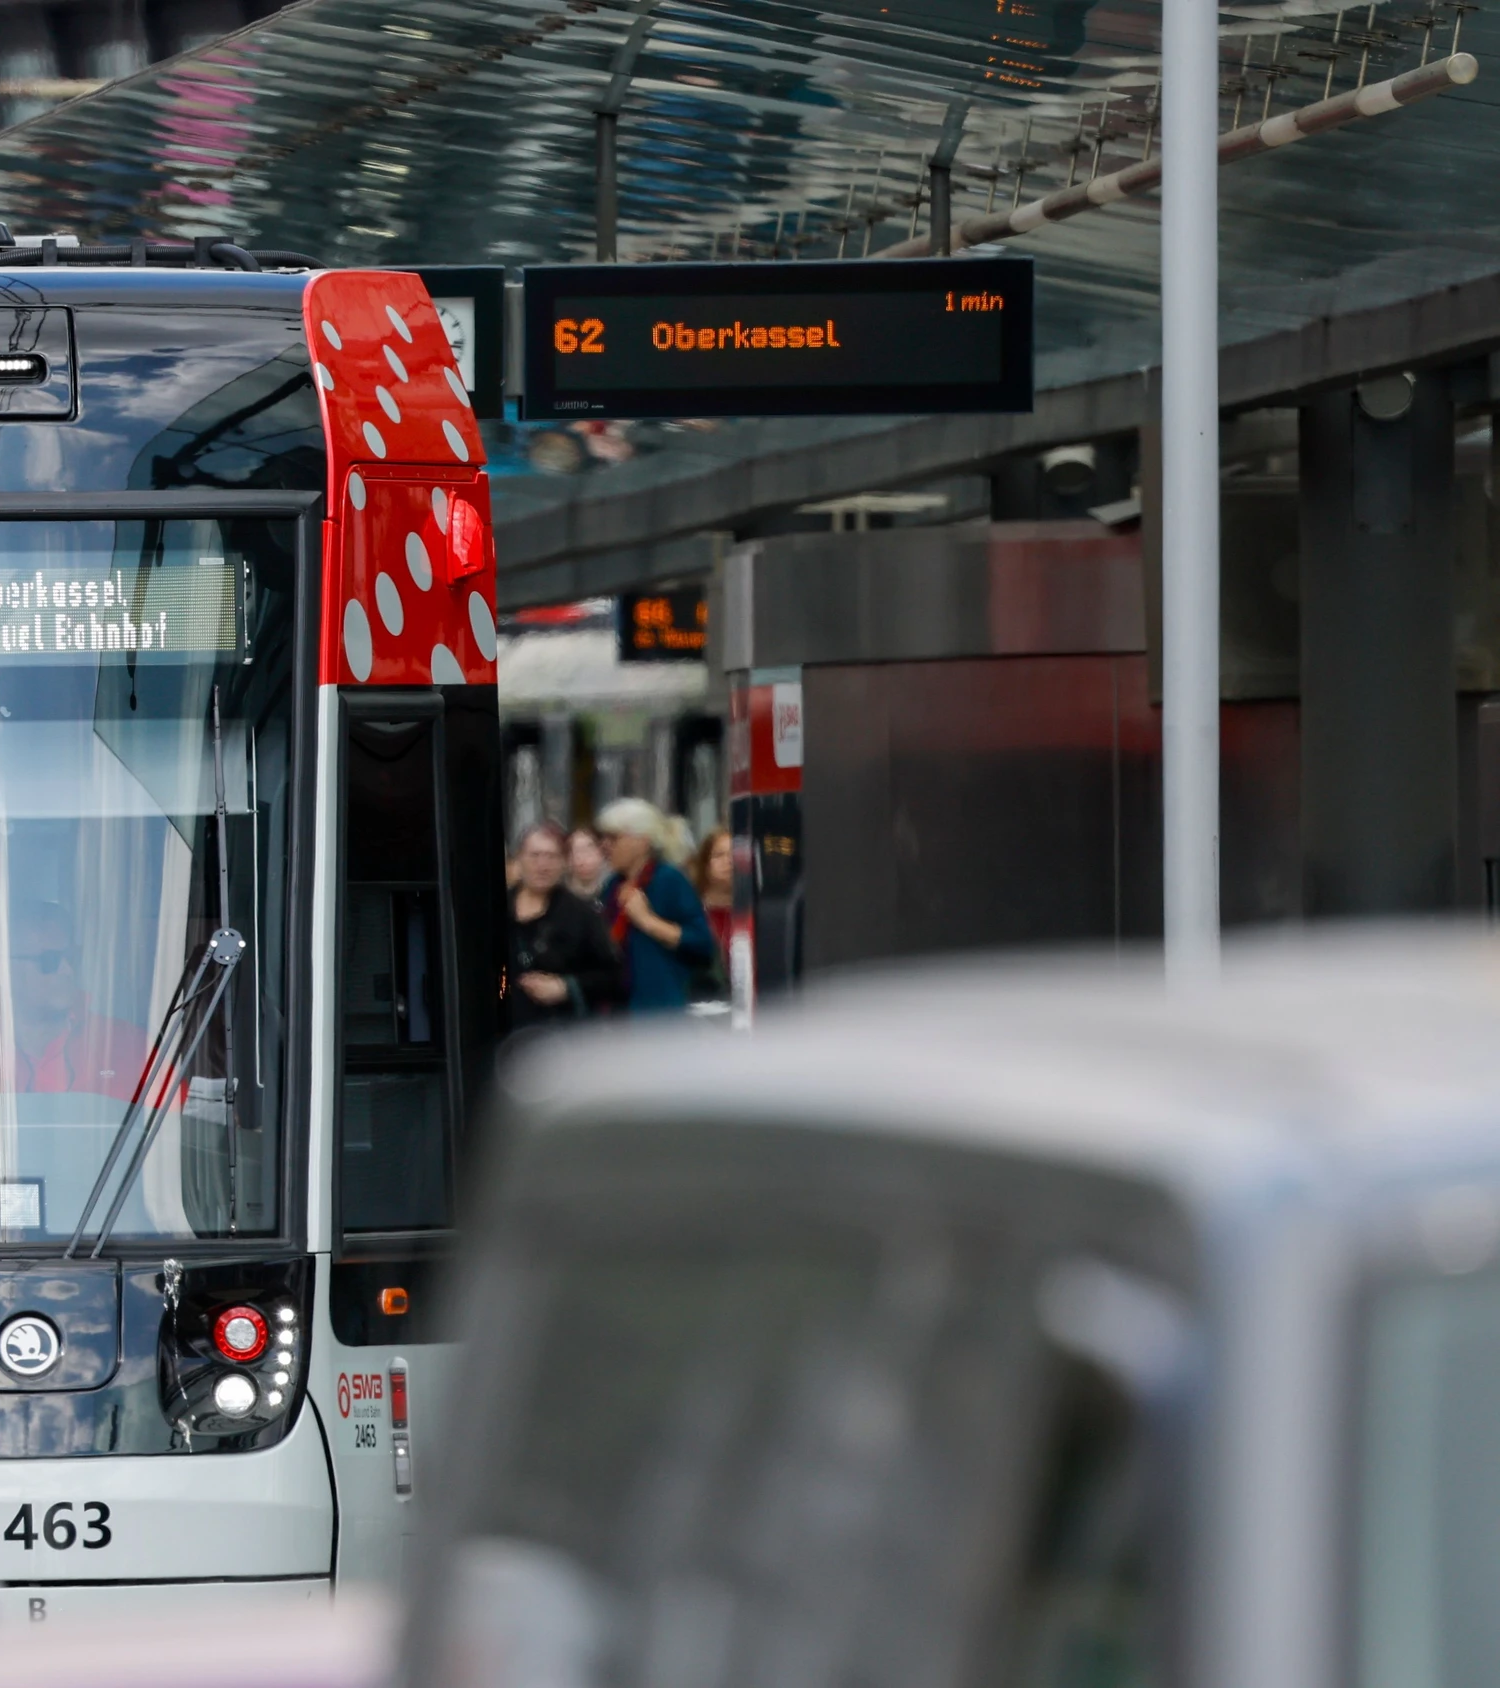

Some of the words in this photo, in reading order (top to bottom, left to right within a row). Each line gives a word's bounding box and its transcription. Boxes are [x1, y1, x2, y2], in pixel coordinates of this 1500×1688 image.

[945, 291, 954, 311] 1
[961, 290, 1004, 311] min
[554, 318, 605, 353] 62
[652, 319, 841, 350] Oberkassel
[55, 612, 167, 650] Bahnhof
[352, 1374, 383, 1400] SWB
[355, 1424, 377, 1448] 2463
[28, 1597, 47, 1623] B
